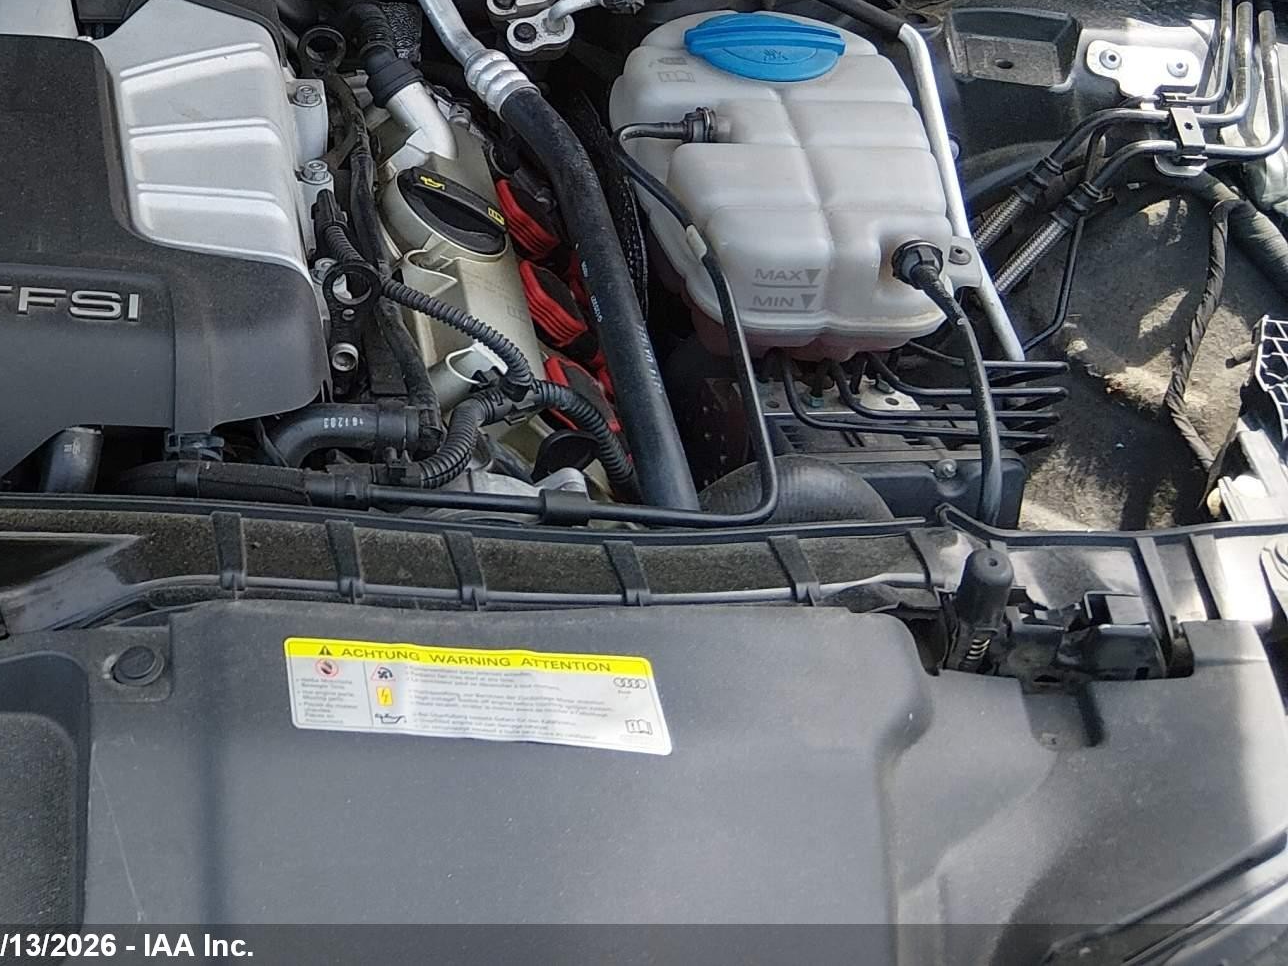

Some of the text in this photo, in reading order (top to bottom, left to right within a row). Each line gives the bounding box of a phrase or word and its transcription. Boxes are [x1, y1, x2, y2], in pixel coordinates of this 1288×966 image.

[754, 268, 803, 282] MAX
[752, 295, 795, 307] MIN
[341, 647, 611, 672] ACHTUNG WARNING ATTENTION
